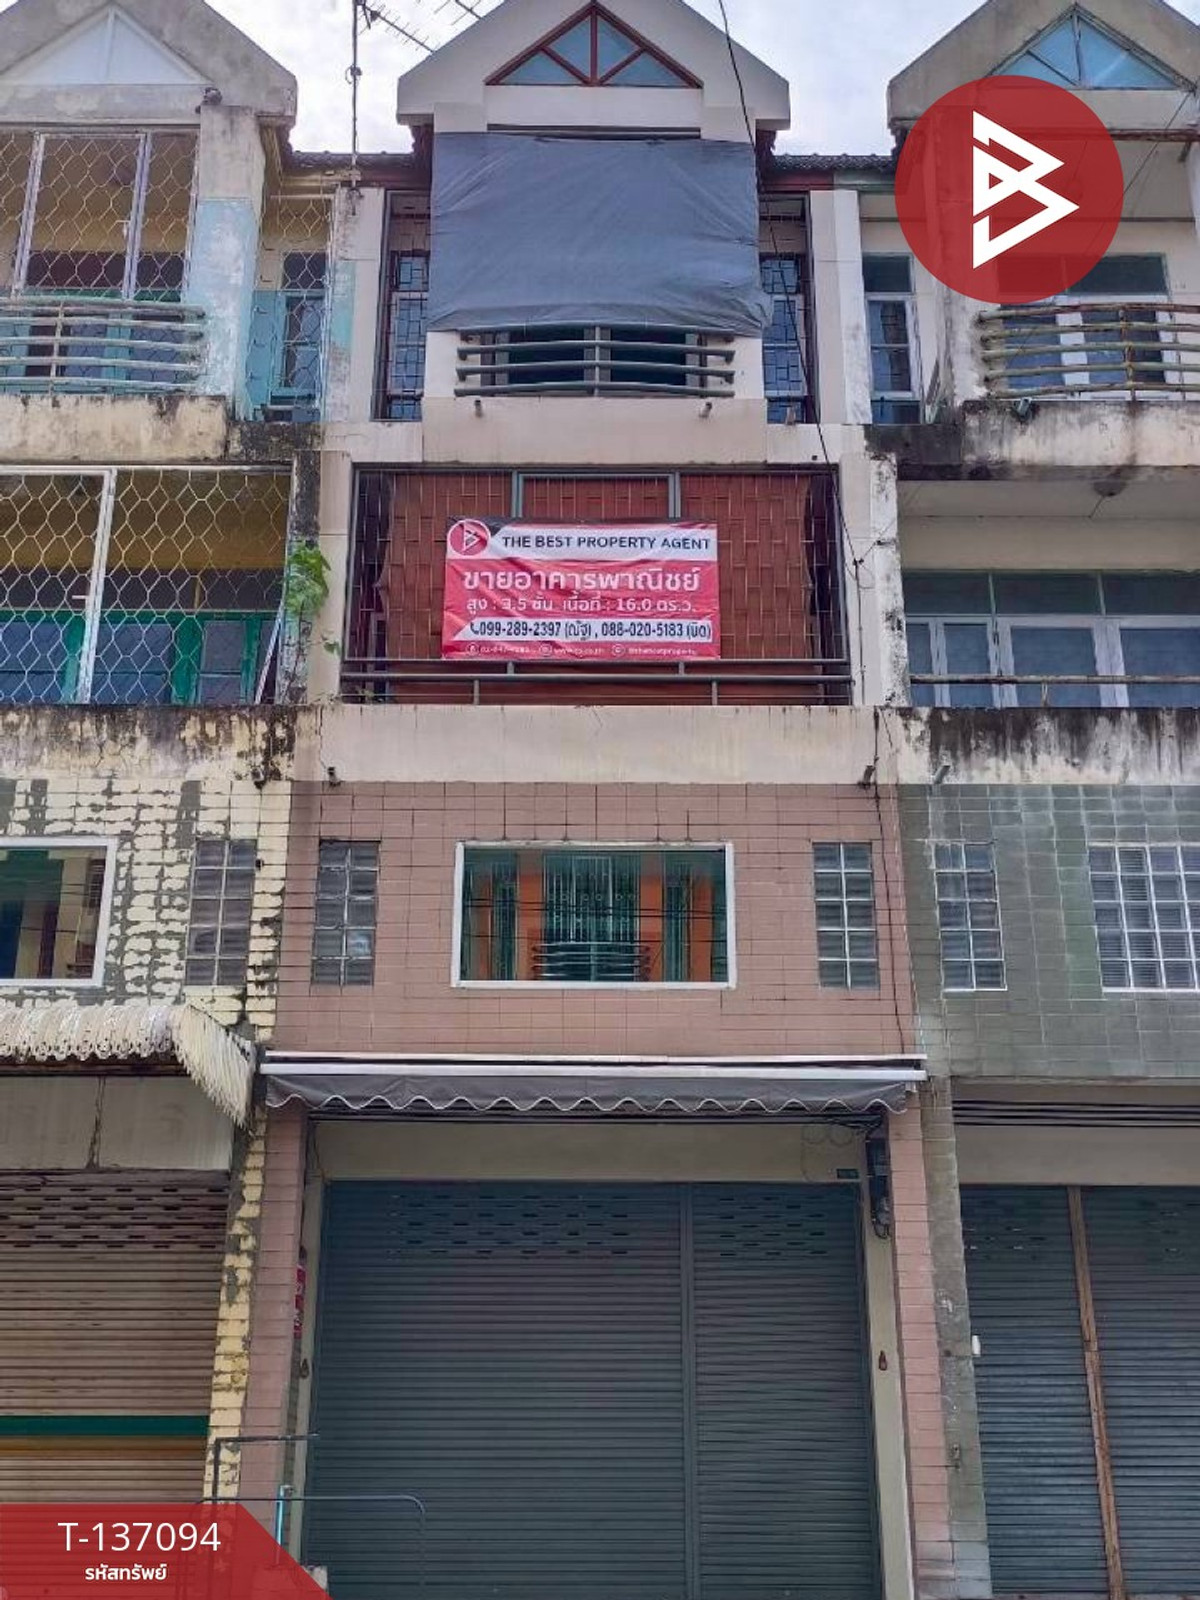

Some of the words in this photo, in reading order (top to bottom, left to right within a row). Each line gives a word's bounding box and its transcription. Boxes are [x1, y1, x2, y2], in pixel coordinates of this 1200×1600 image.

[502, 536, 532, 549] THE
[535, 536, 573, 549] BEST
[577, 536, 656, 549] PROPERTY
[660, 537, 711, 550] AGENT
[463, 567, 701, 591] ขายอาคารพาณิชย์
[501, 598, 527, 611] 3.5
[616, 598, 652, 612] 16.0
[480, 621, 561, 636] 099-289-2397
